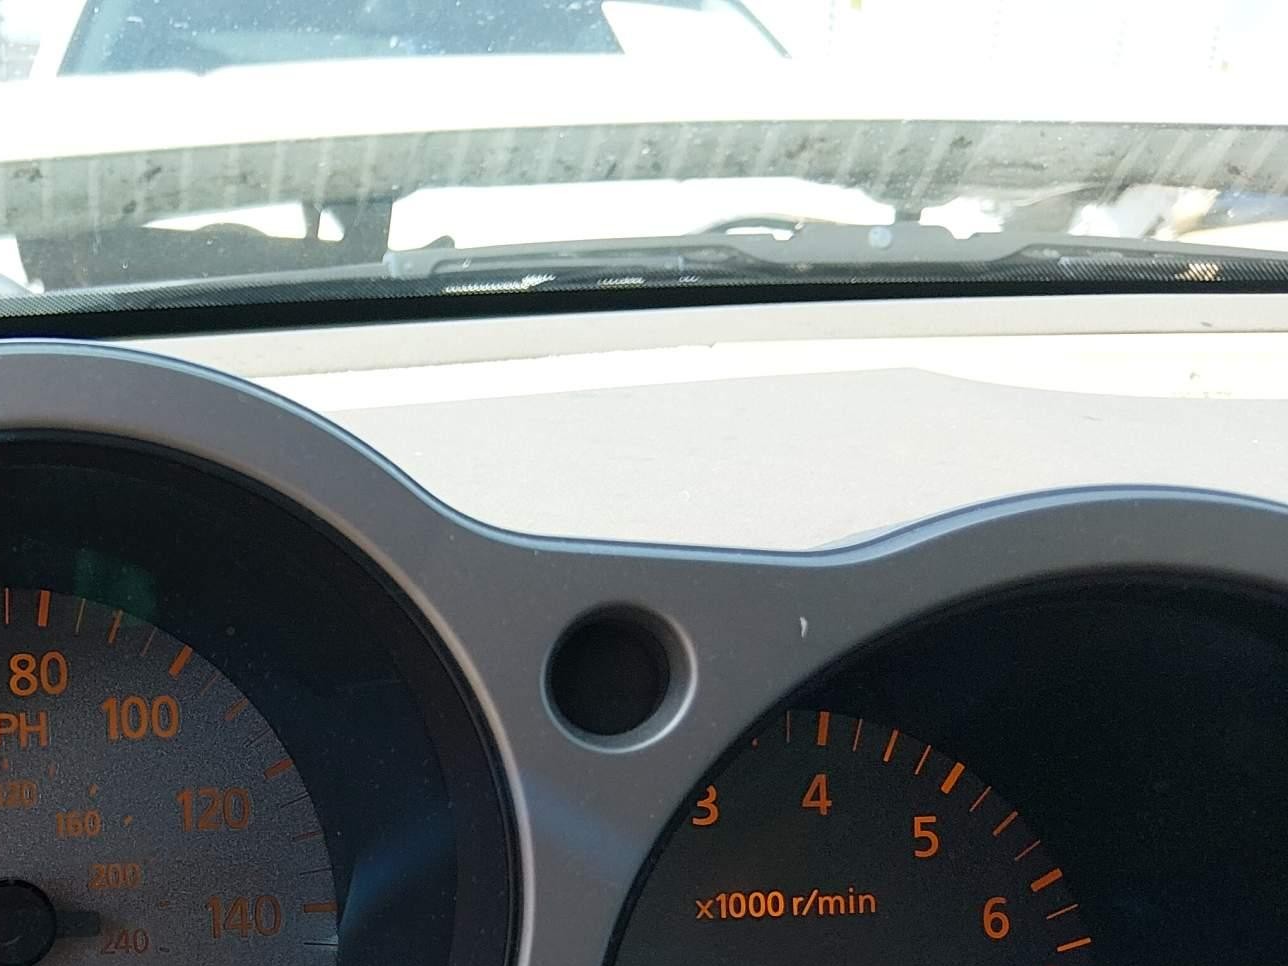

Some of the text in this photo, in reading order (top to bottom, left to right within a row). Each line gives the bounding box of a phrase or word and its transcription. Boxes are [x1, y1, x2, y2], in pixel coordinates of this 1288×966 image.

[9, 650, 68, 697] 80
[101, 695, 179, 741] 100
[176, 786, 251, 832] 120
[691, 785, 720, 826] 3
[802, 774, 832, 815] 4
[55, 810, 102, 839] 160
[913, 815, 940, 858] 5
[88, 863, 142, 890] 200
[208, 894, 282, 940] 140
[792, 888, 877, 916] r/min
[982, 897, 1010, 939] 6
[100, 927, 150, 954] 240
